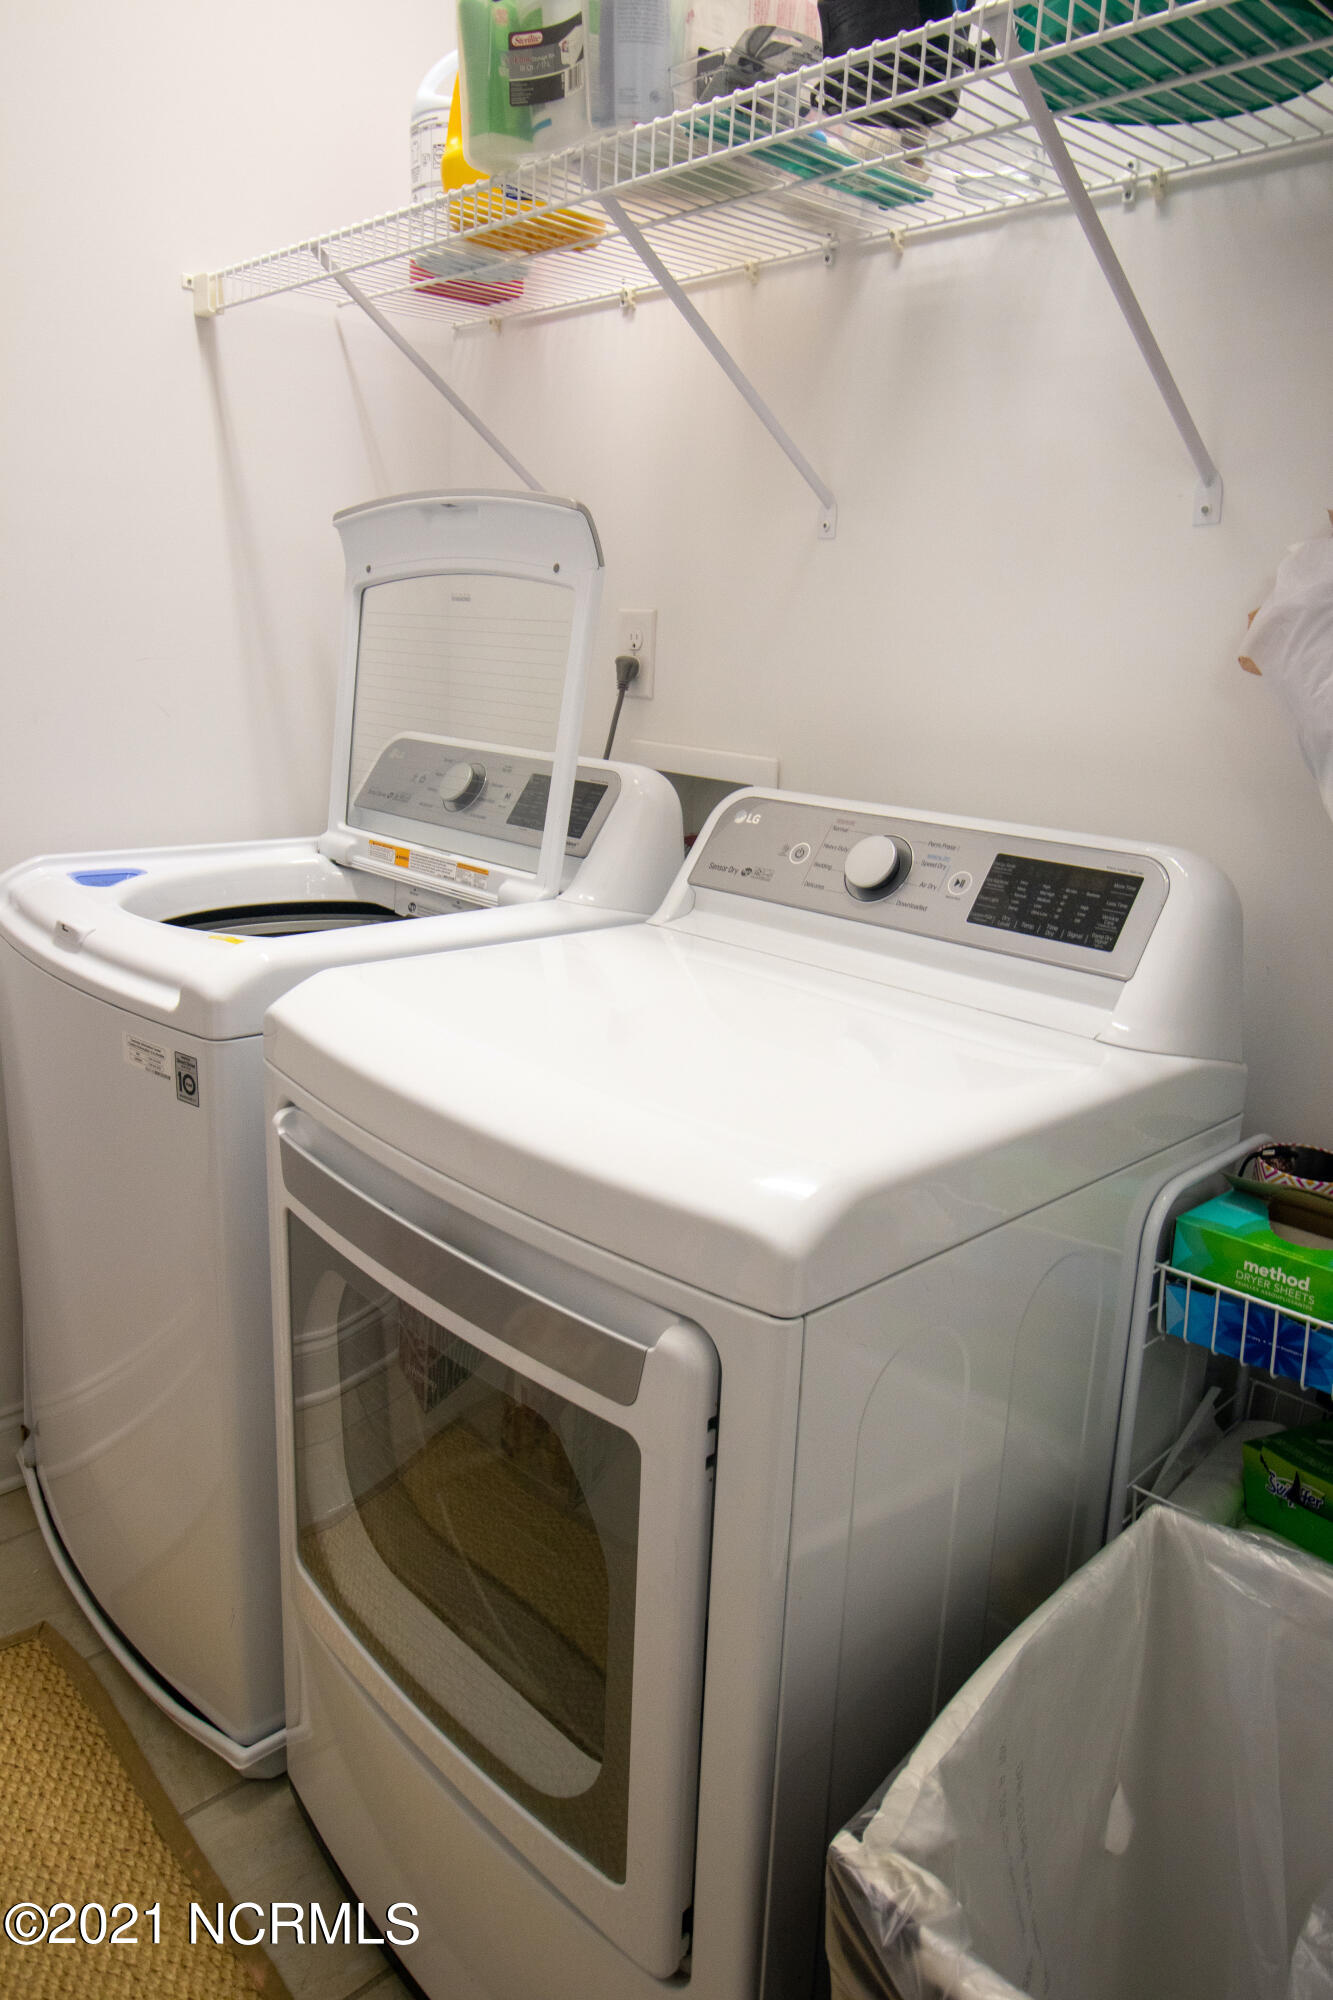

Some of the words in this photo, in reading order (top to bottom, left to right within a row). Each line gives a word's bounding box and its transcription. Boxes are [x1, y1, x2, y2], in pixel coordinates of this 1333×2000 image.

[746, 813, 762, 825] LG
[708, 862, 728, 874] Sensor
[728, 864, 739, 875] Dry
[920, 859, 937, 869] Speed
[936, 862, 947, 872] Dry
[1243, 1260, 1311, 1292] method
[1235, 1269, 1271, 1290] DRYER
[1274, 1283, 1315, 1305] SHEETS
